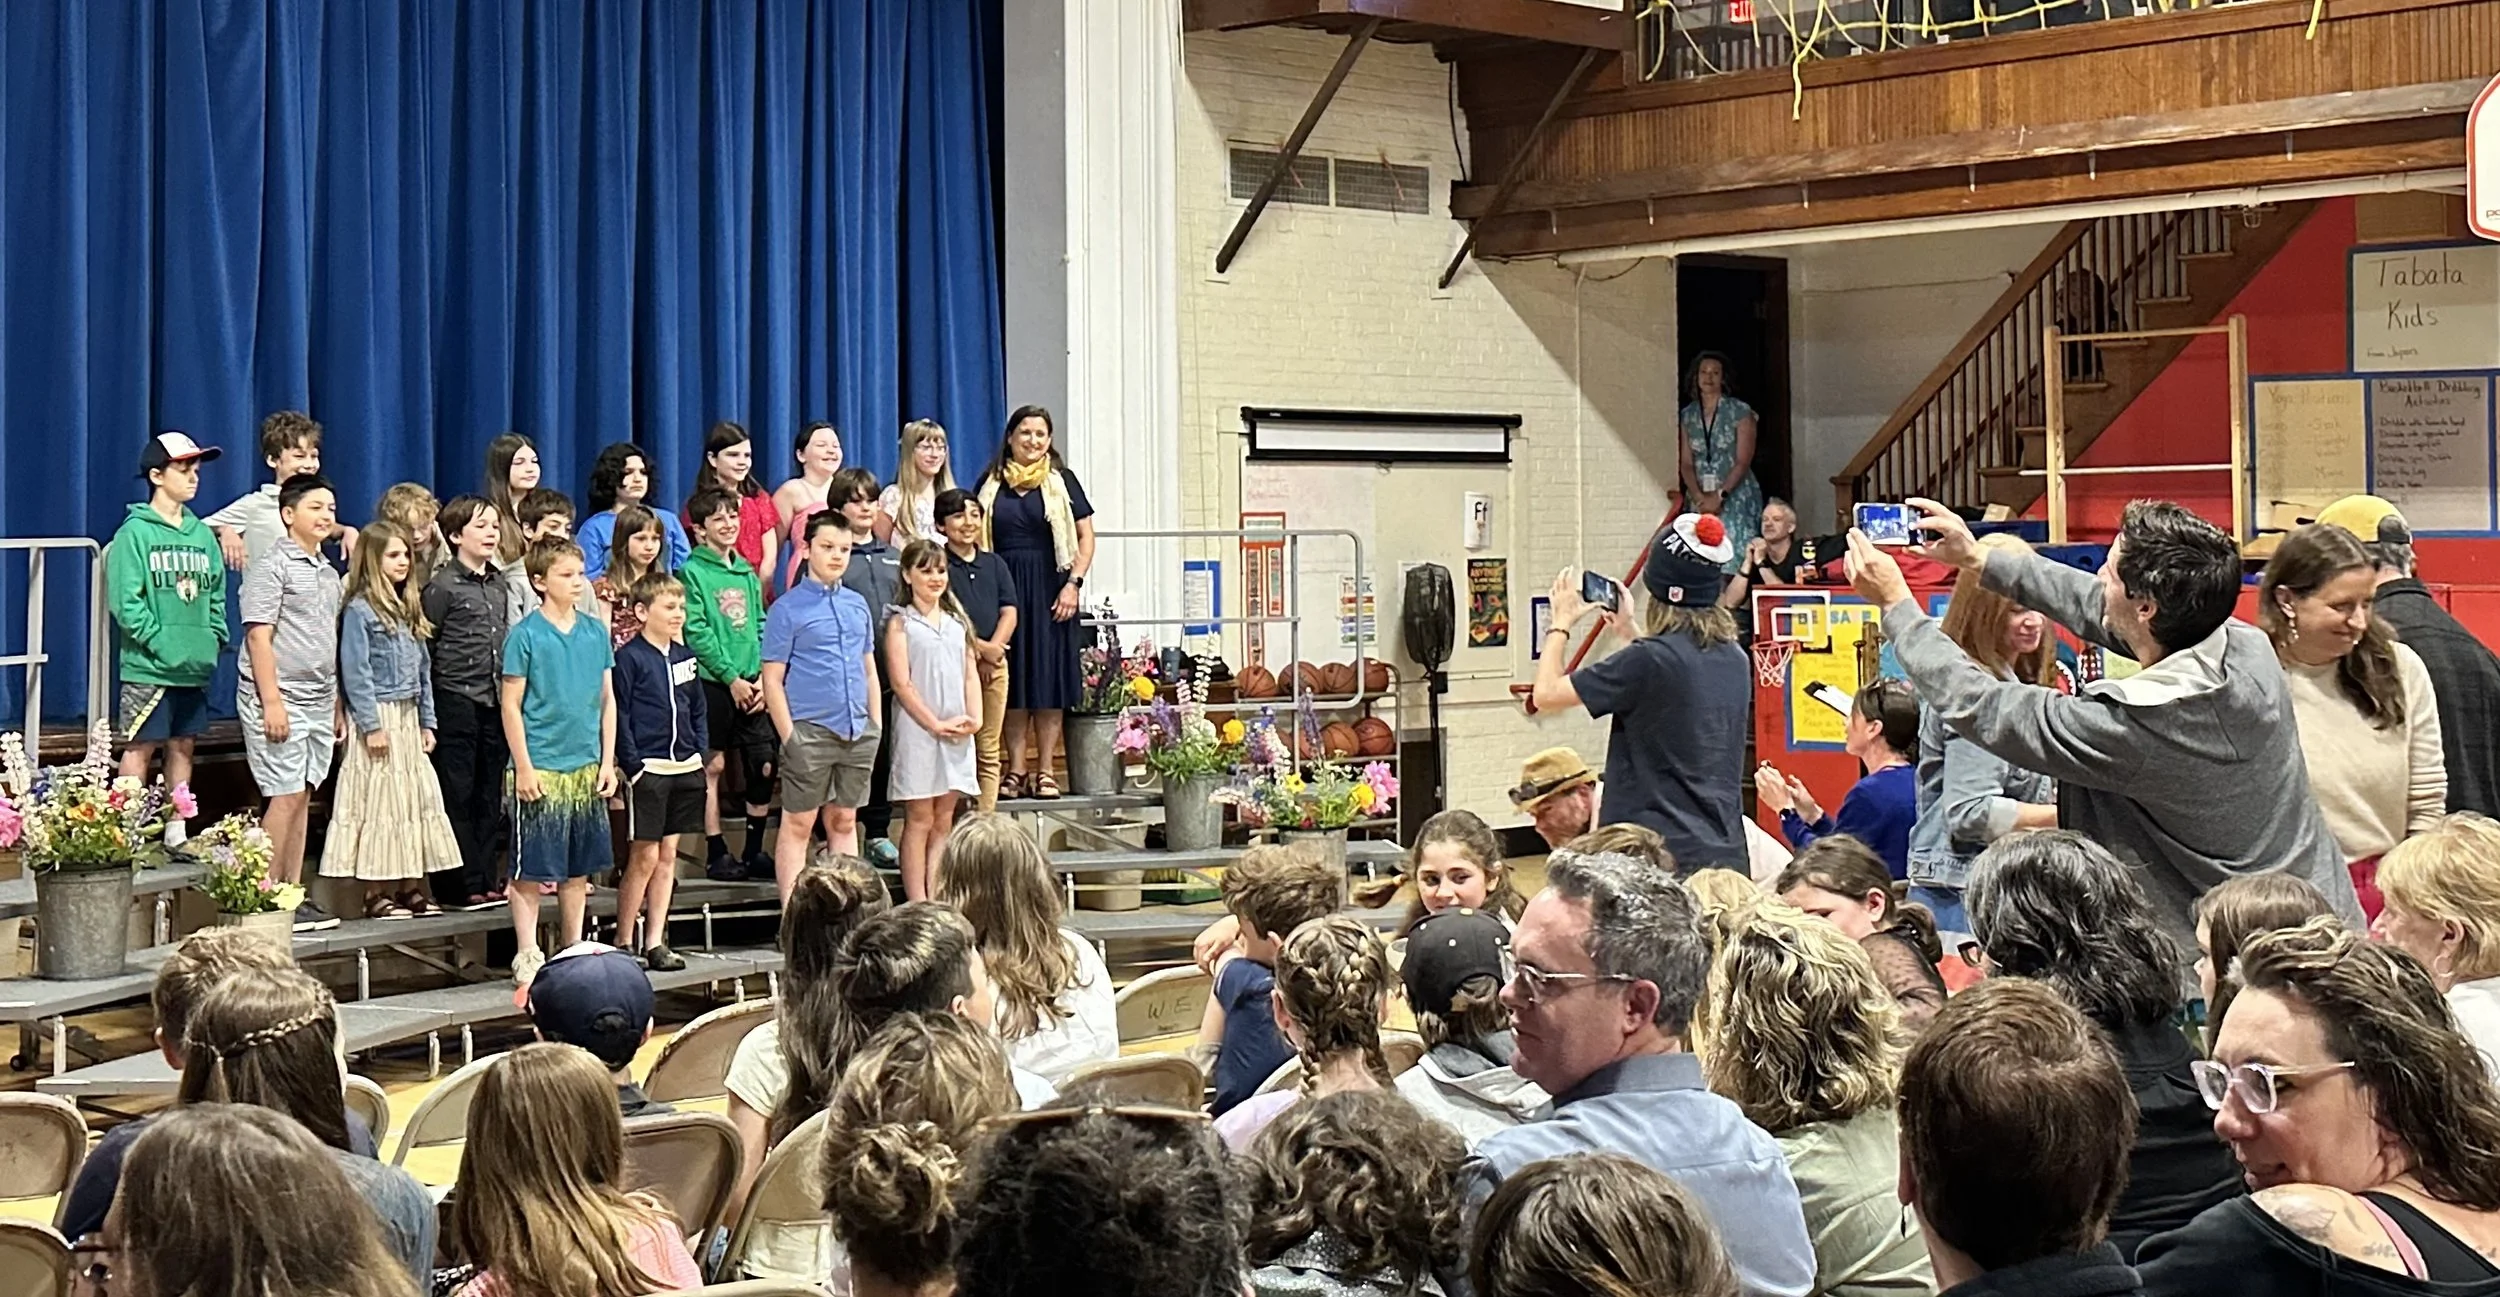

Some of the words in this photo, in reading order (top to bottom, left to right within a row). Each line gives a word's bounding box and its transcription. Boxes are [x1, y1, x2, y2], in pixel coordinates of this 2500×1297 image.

[2367, 251, 2468, 288] Tabata
[2388, 299, 2439, 331] Kids
[1474, 501, 1488, 521] Ff
